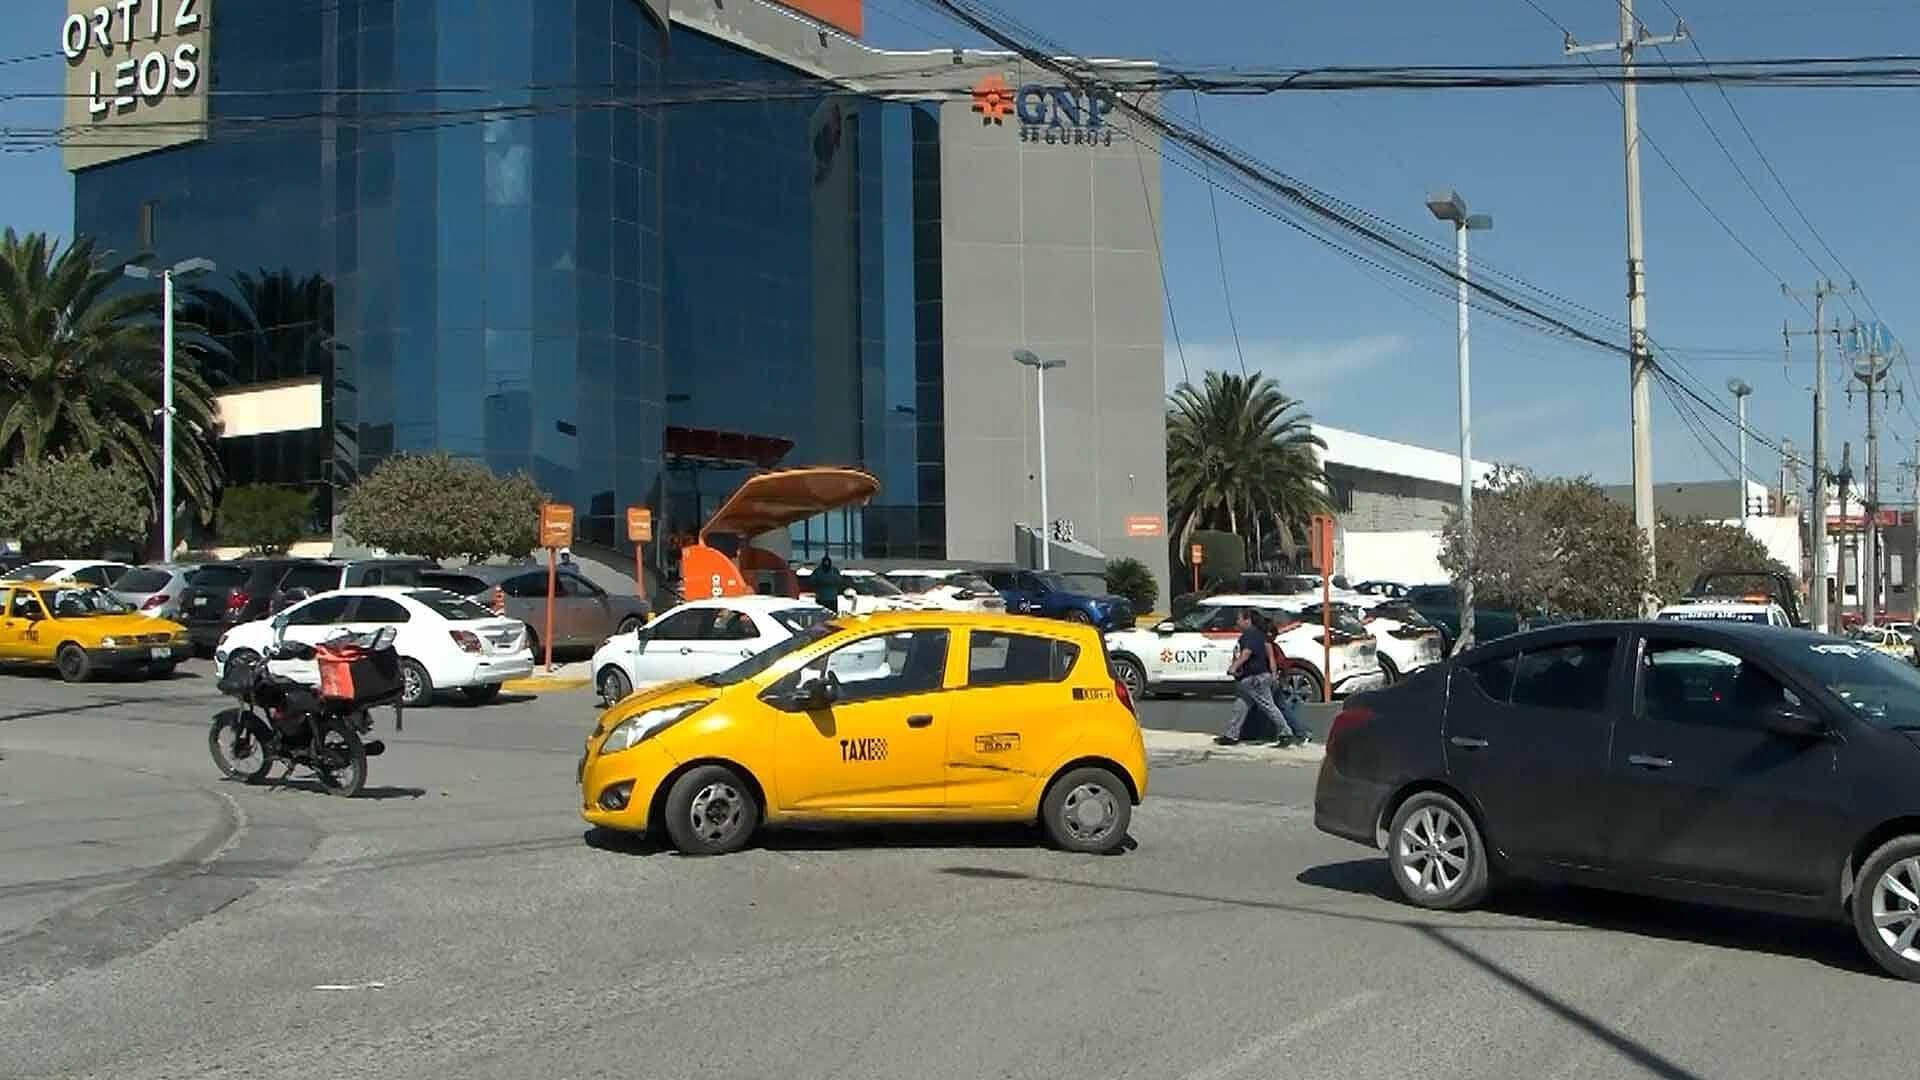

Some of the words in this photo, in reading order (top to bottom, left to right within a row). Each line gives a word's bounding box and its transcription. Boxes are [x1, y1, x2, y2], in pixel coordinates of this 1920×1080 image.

[63, 0, 199, 57] ORTIZ
[89, 44, 196, 113] LEOS
[1016, 84, 1113, 127] GNP
[1020, 128, 1112, 146] SEGUROS
[1175, 650, 1207, 663] GNP
[840, 738, 871, 762] TAXI
